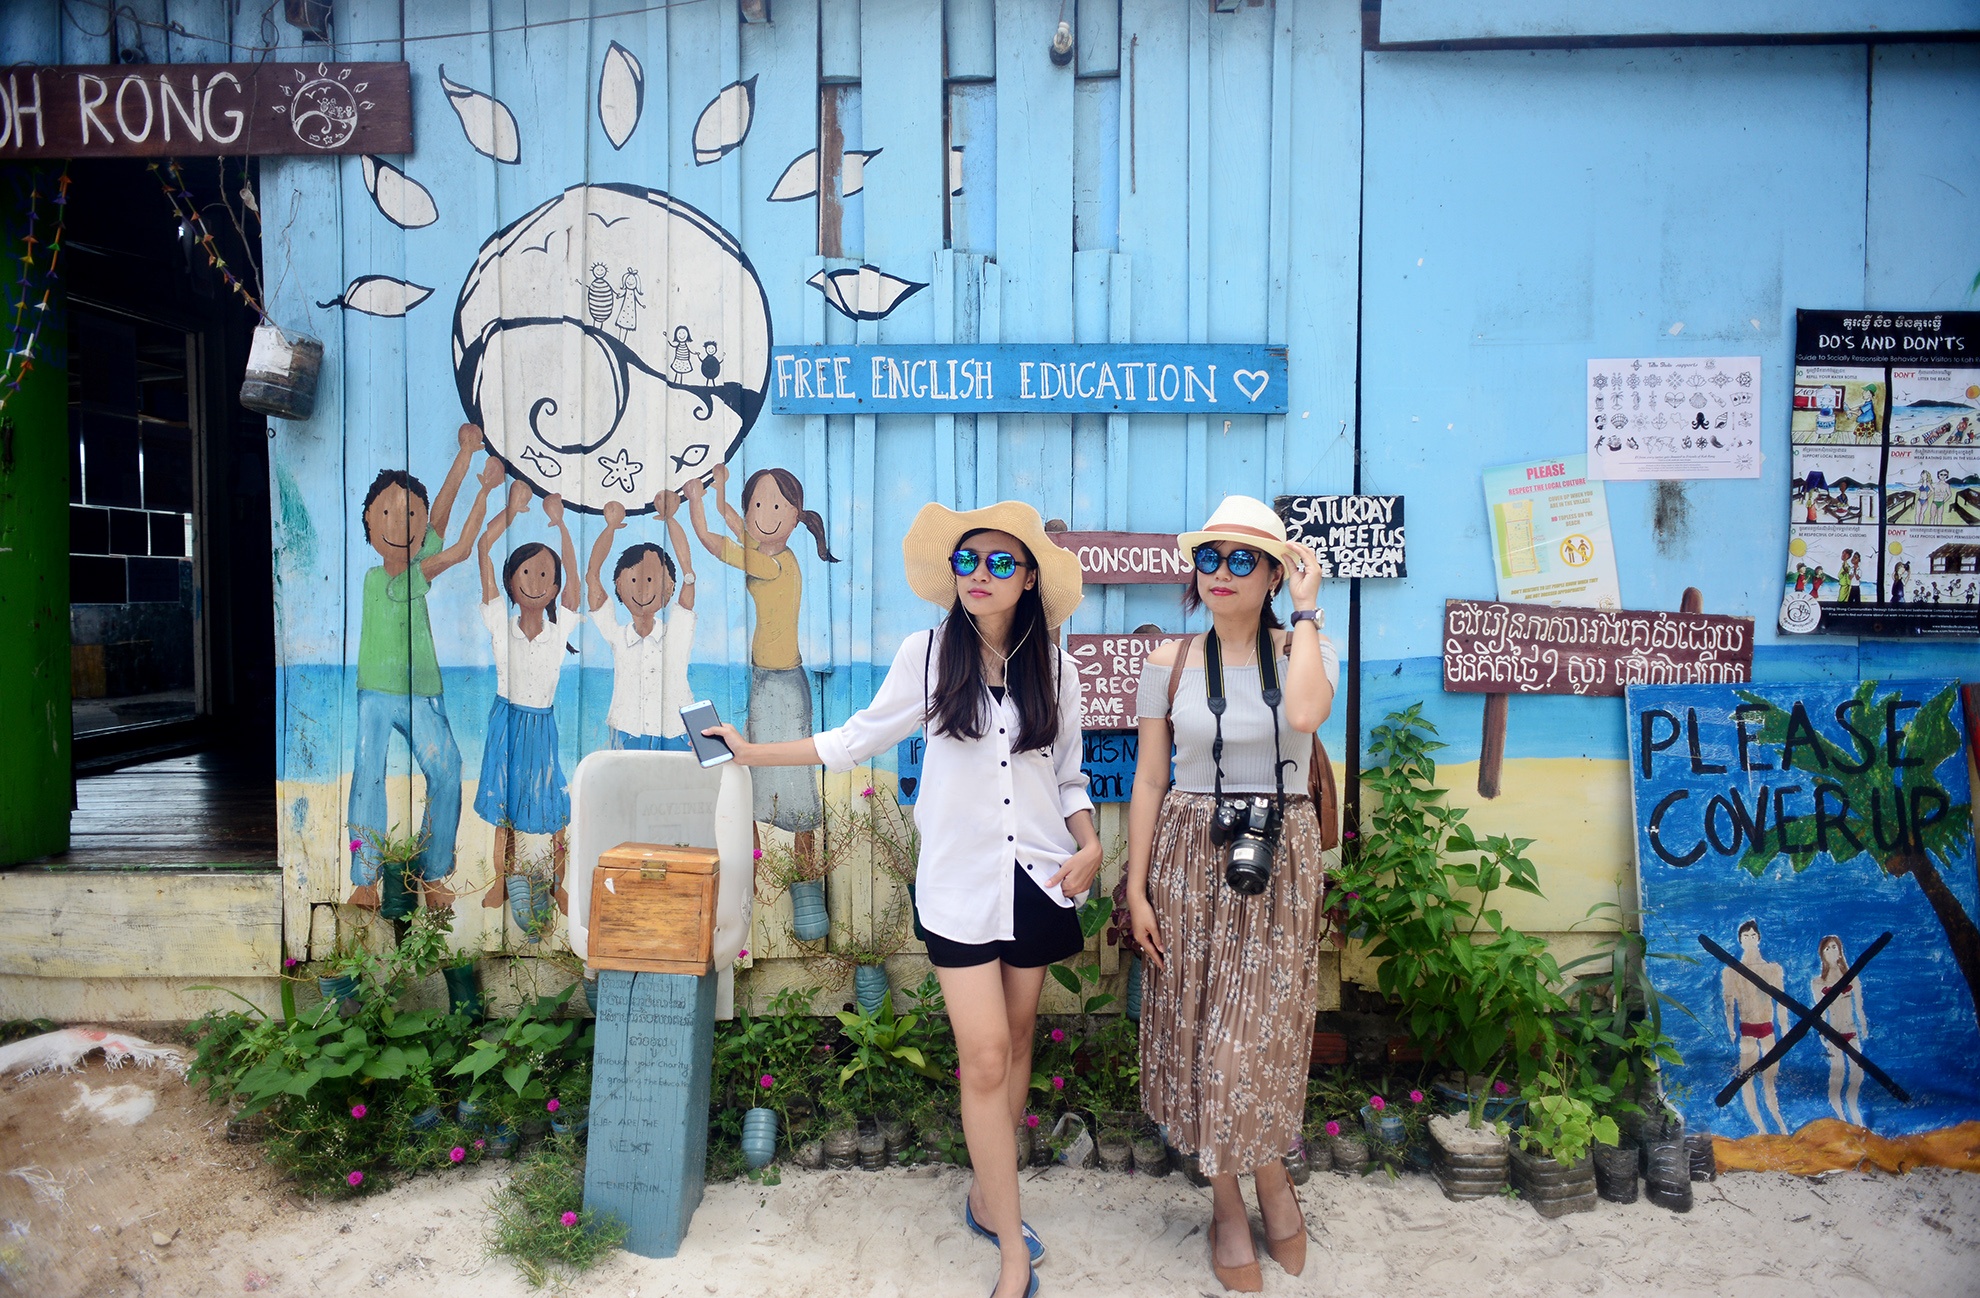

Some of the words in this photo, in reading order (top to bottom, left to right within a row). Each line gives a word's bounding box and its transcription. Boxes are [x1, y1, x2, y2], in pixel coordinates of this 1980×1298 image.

[78, 70, 244, 144] RONG
[1818, 334, 1856, 349] DO'S
[1861, 336, 1896, 350] AND
[1903, 336, 1965, 350] DON'TS
[1827, 354, 1850, 362] Socially
[1852, 354, 1889, 363] Responsible
[774, 354, 857, 399] FREE
[872, 356, 993, 400] ENGLISH
[1019, 360, 1218, 404] EDUCATION
[1526, 463, 1566, 480] PLEASE
[1508, 486, 1532, 496] RESPECT
[1534, 484, 1544, 492] THE
[1545, 482, 1562, 490] LOCAL
[1562, 478, 1586, 487] CULTURE
[1289, 496, 1395, 524] SATURDAY
[1354, 548, 1403, 564] CLEAN
[1338, 562, 1398, 578] BEACH
[1103, 638, 1184, 657] REDU
[1113, 656, 1146, 676] RE
[1080, 716, 1122, 728] ESPECT
[1640, 699, 1925, 780] PLEASE
[910, 737, 924, 766] If
[1081, 735, 1119, 764] ild's
[1648, 784, 1864, 868] COVER
[1872, 785, 1950, 856] UP
[642, 1118, 658, 1128] THE
[610, 1140, 652, 1155] NEXT
